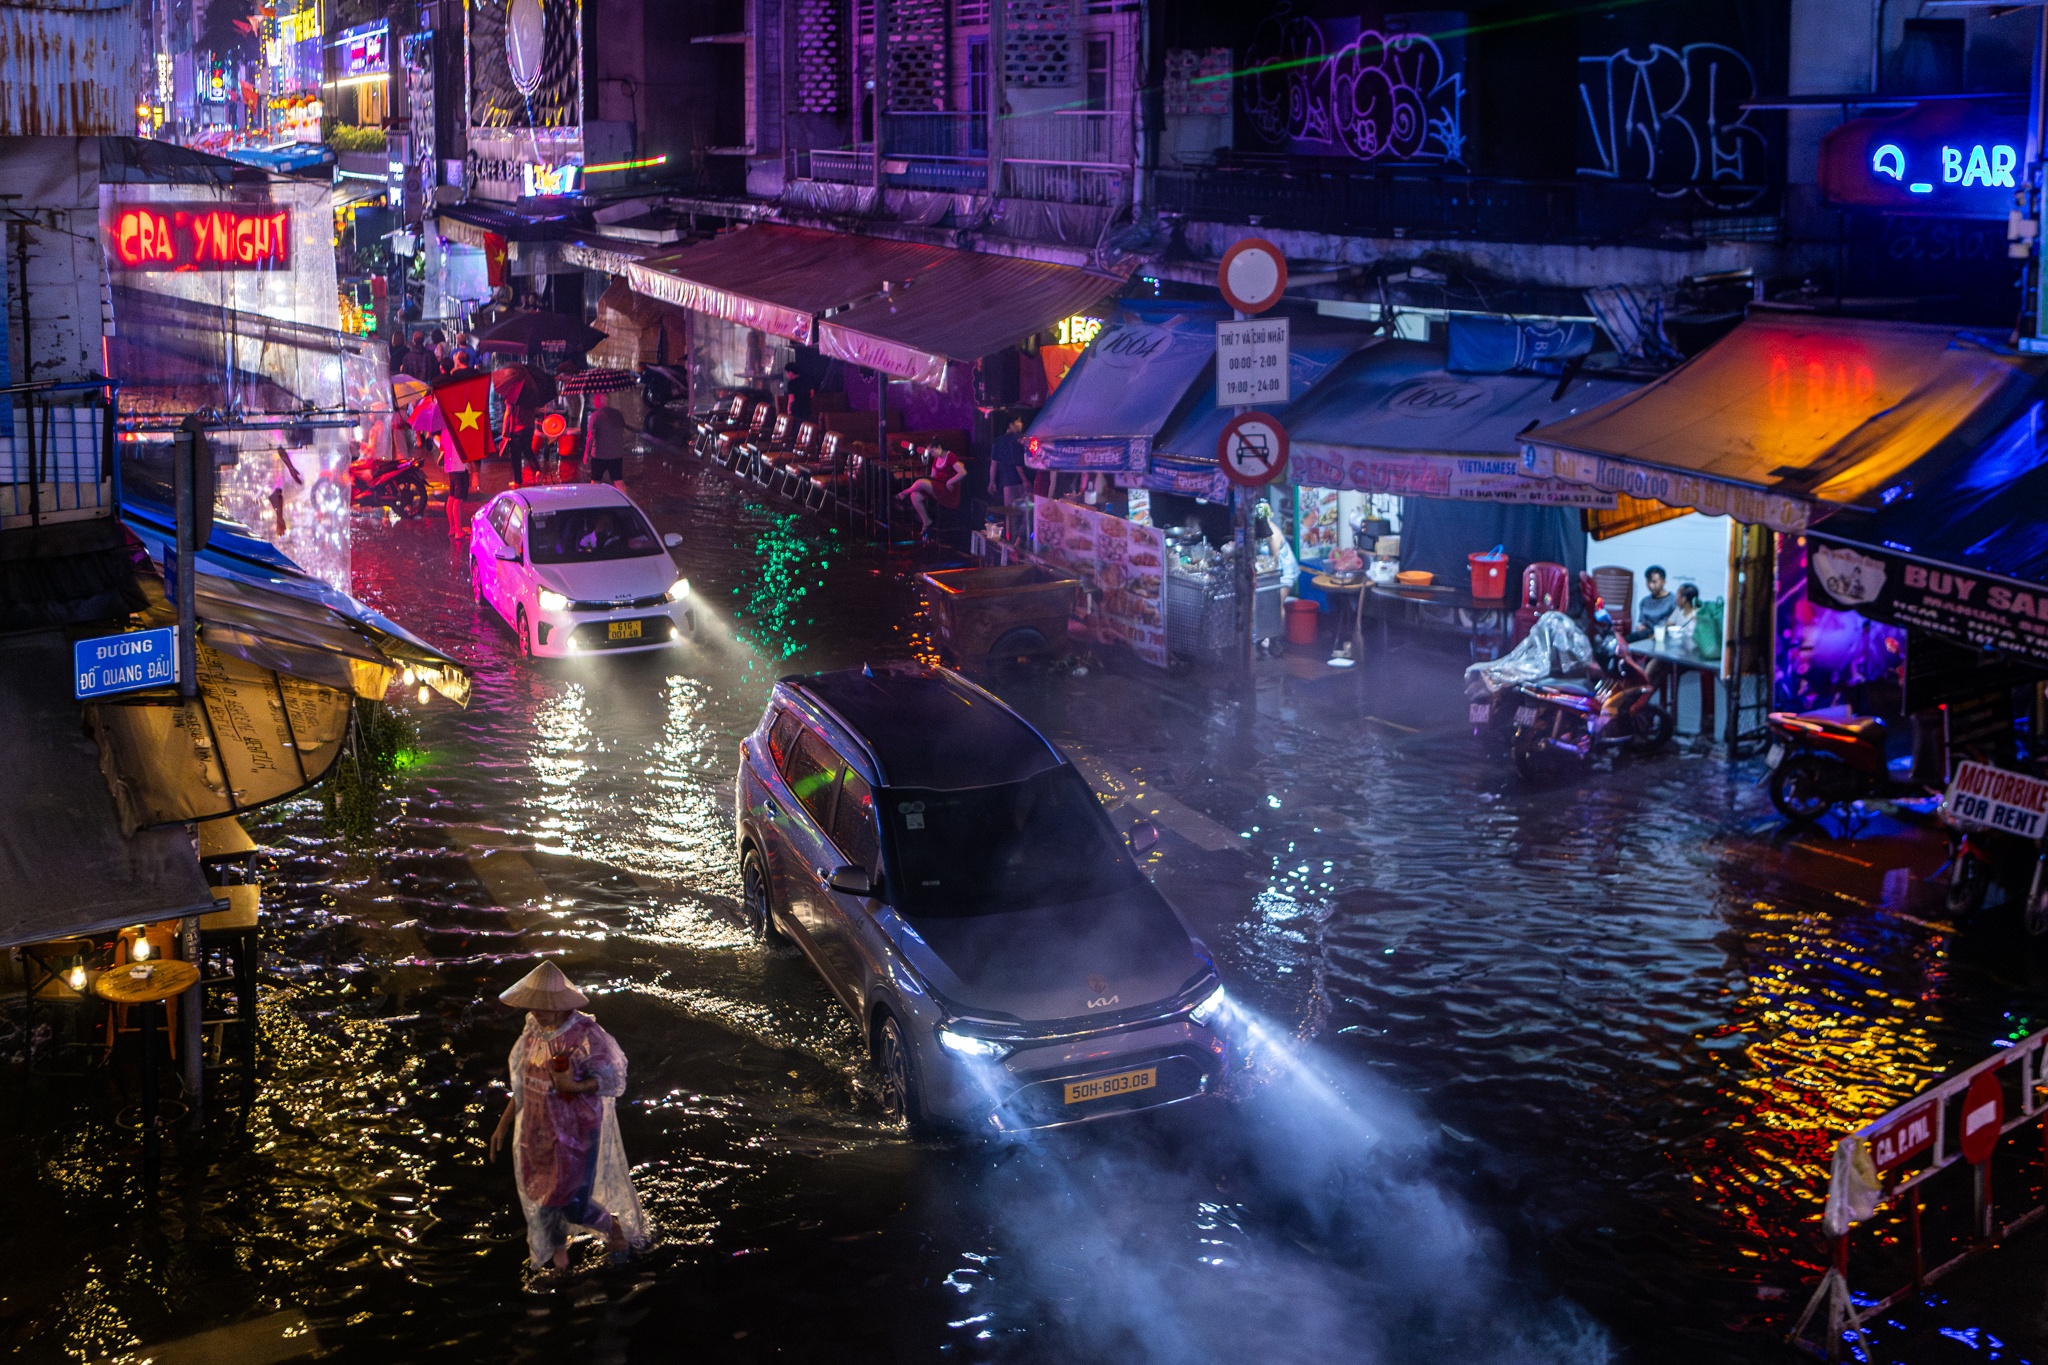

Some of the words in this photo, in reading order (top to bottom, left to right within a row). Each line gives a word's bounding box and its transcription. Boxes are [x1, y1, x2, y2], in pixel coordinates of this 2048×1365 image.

[475, 158, 496, 181] CAFE
[1942, 145, 2017, 188] BAR
[1102, 331, 1166, 358] 1664
[1236, 333, 1240, 345] 7
[1458, 460, 1516, 476] VIETNAMESE
[1904, 565, 1977, 600] BUY
[96, 639, 153, 660] ĐƯỜNG
[80, 665, 100, 690] ĐỖ
[103, 664, 142, 686] QUANG
[147, 653, 170, 679] ĐẨU
[1956, 764, 2048, 815] MOTORBIKE
[1953, 792, 1989, 821] FOR
[1992, 804, 2041, 834] RENT
[1072, 1073, 1149, 1100] 50H-803.08
